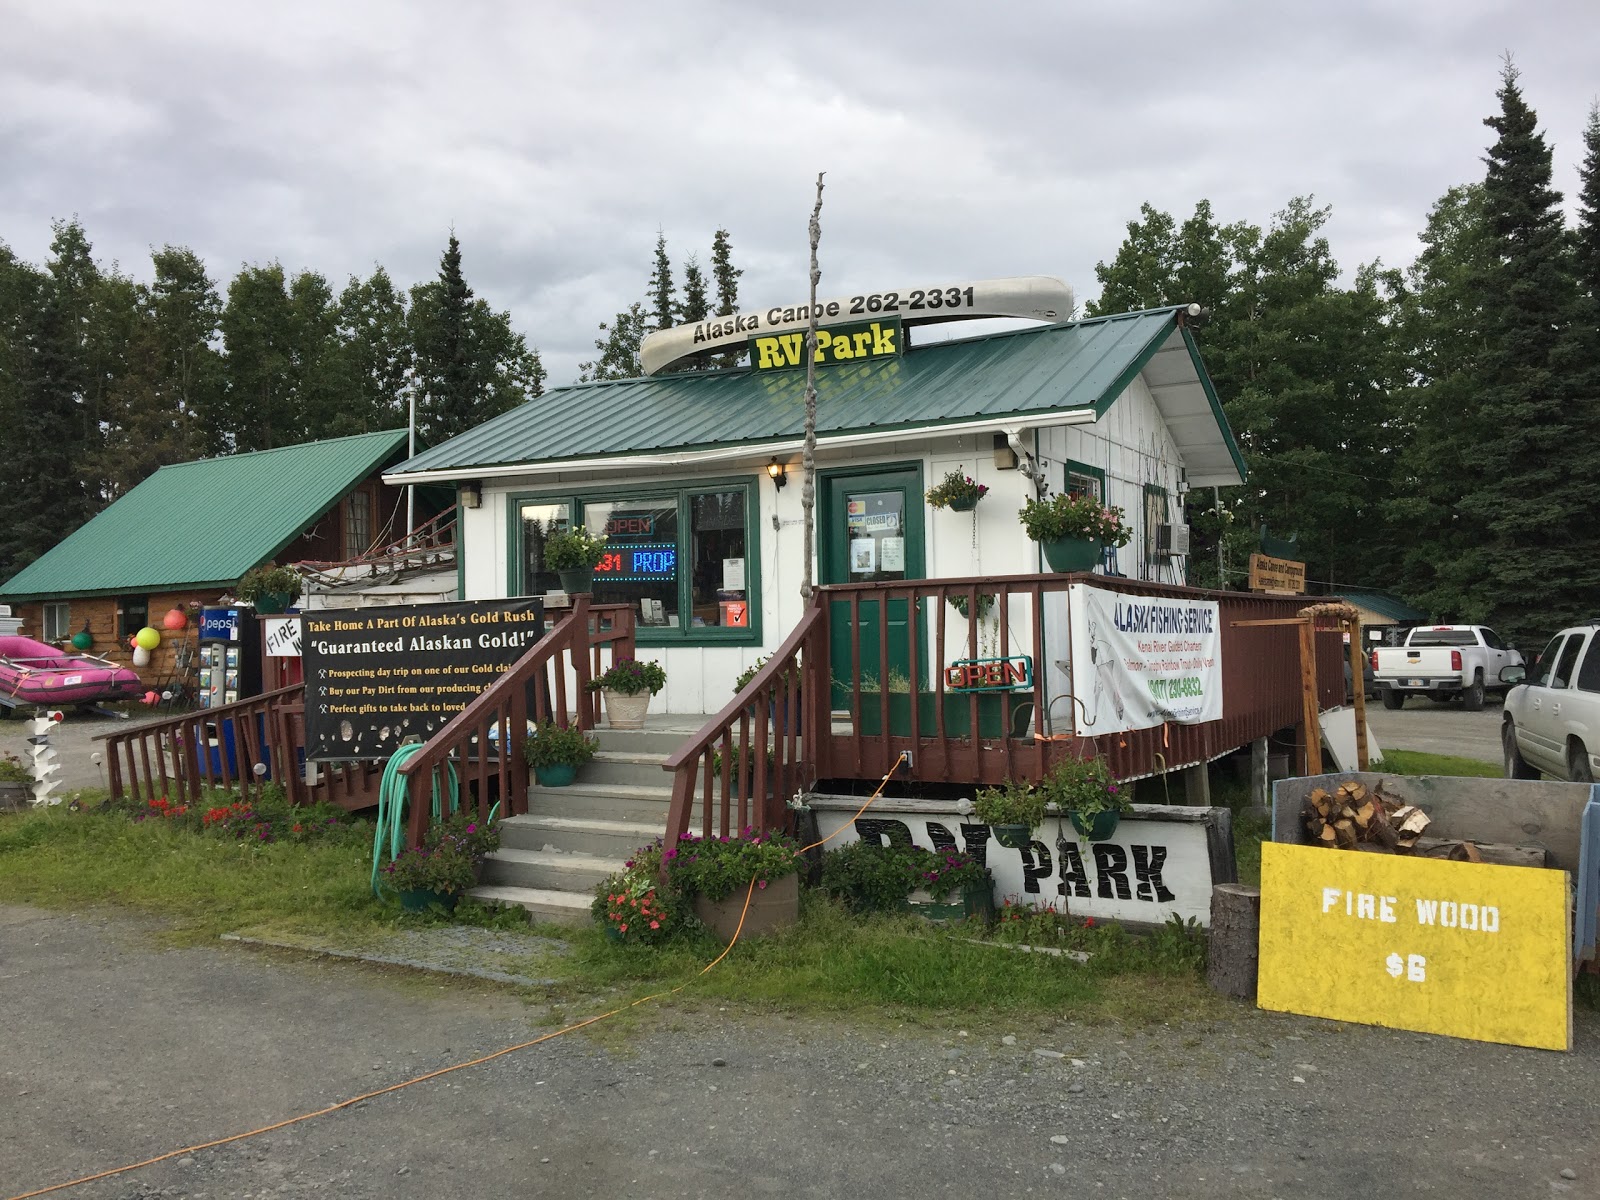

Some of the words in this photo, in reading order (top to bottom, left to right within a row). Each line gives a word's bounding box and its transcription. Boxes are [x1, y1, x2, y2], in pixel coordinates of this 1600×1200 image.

[693, 314, 759, 344] Alaska
[767, 301, 840, 326] Canoe
[849, 286, 974, 315] 262-2331
[756, 333, 804, 369] RV
[813, 322, 896, 363] Park
[866, 515, 886, 525] CLOSED
[633, 552, 673, 573] PROP
[206, 617, 235, 631] pepsi
[308, 621, 331, 632] Take
[334, 620, 364, 631] Home
[367, 619, 374, 629] A
[377, 617, 400, 629] Part
[402, 615, 417, 628] Of
[419, 613, 466, 627] Alaska's
[470, 611, 499, 624] Gold
[503, 610, 535, 622] Rush
[1150, 606, 1183, 634] FISHING
[1184, 608, 1213, 634] SERVICE
[267, 619, 297, 654] FIRE
[410, 634, 472, 652] Alaskan
[1137, 641, 1152, 653] Kenai
[1153, 641, 1167, 653] River
[328, 668, 376, 679] Prospecting
[377, 667, 391, 678] day
[393, 667, 409, 678] trip
[424, 667, 440, 675] one
[442, 665, 453, 674] of
[454, 666, 470, 674] our
[472, 664, 493, 673] Gold
[495, 663, 512, 672] clai
[944, 661, 1027, 687] OPEN
[329, 687, 344, 697] Buy
[362, 686, 376, 696] Pay
[378, 685, 395, 694] Dirt
[397, 685, 417, 694] from
[437, 684, 481, 694] producing
[1169, 676, 1203, 699] 230-8832
[329, 704, 357, 713] Perfect
[359, 703, 377, 714] gifts
[379, 704, 388, 712] to
[390, 703, 408, 712] take
[410, 703, 429, 712] back
[431, 703, 440, 711] to
[443, 702, 466, 711] loved
[1022, 838, 1175, 902] PARK
[1322, 888, 1397, 923] FIRE
[1416, 899, 1499, 933] WOOD
[1386, 953, 1426, 982] $6
